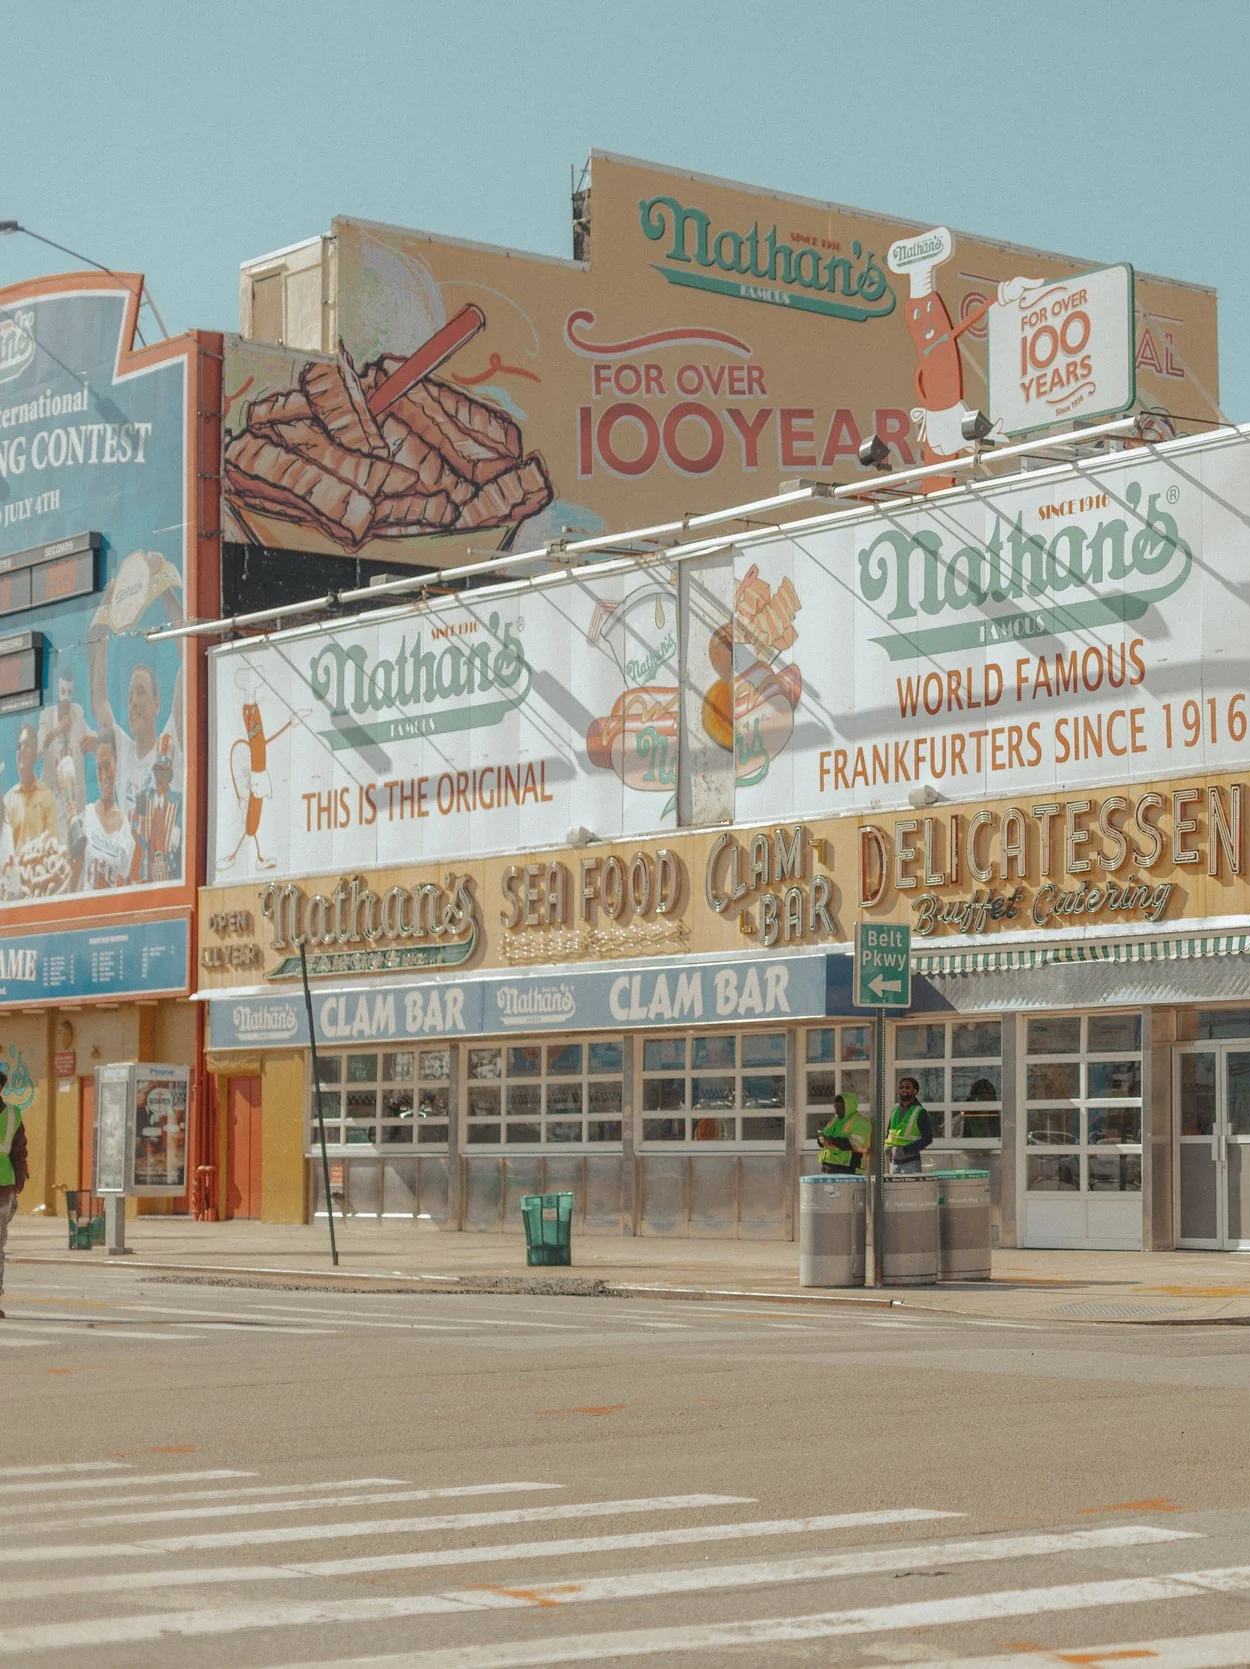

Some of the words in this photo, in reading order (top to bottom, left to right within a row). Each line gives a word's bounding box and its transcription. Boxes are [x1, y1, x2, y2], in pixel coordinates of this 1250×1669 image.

[638, 195, 892, 302] Nathan's
[893, 235, 944, 262] Nathan's
[739, 284, 791, 305] FAMOUS
[1020, 308, 1048, 333] FOR
[1052, 288, 1088, 318] OVER
[1021, 310, 1091, 378] 100
[593, 364, 667, 399] FOR
[683, 365, 768, 397] OVER
[1020, 354, 1093, 404] YEARS
[31, 421, 152, 471] CONTEST
[577, 402, 725, 478] 100
[725, 408, 927, 471] YEAR
[4, 498, 33, 528] JULY
[35, 489, 60, 514] 4TH
[1038, 499, 1078, 521] SINCE
[1079, 491, 1110, 512] 1916
[858, 481, 1178, 621] Nathan's
[979, 615, 1046, 643] FAMOUS
[310, 611, 525, 718] Nathan's
[626, 632, 677, 681] Nathan's
[896, 662, 1001, 719] WORLD
[1016, 638, 1146, 703] FAMOUS
[390, 717, 435, 737] FAMOUS
[818, 720, 1042, 793] FRANKFURTERS
[1054, 705, 1146, 766] SINCE
[1162, 693, 1248, 750] 1916
[302, 786, 351, 832] THIS
[358, 782, 378, 825] IS
[383, 776, 429, 821] THE
[436, 760, 553, 815] ORIGINAL
[705, 825, 806, 914] CLAM
[858, 783, 1245, 909] DELICATESSEN
[258, 872, 476, 950] Nathan's
[500, 859, 568, 929] SEA
[579, 848, 681, 922] FOOD
[758, 872, 838, 947] BAR
[911, 886, 1023, 937] Buffet
[1032, 873, 1174, 927] Catering
[209, 911, 250, 933] OPEN
[868, 930, 902, 947] Belt
[862, 950, 907, 972] Pkwy
[232, 1003, 297, 1032] Nathan's
[320, 994, 396, 1038] CLAM
[403, 988, 466, 1034] BAR
[496, 983, 575, 1014] Nathan's
[609, 968, 704, 1022] CLAM
[713, 964, 791, 1017] BAR
[149, 1067, 175, 1076] Phone
